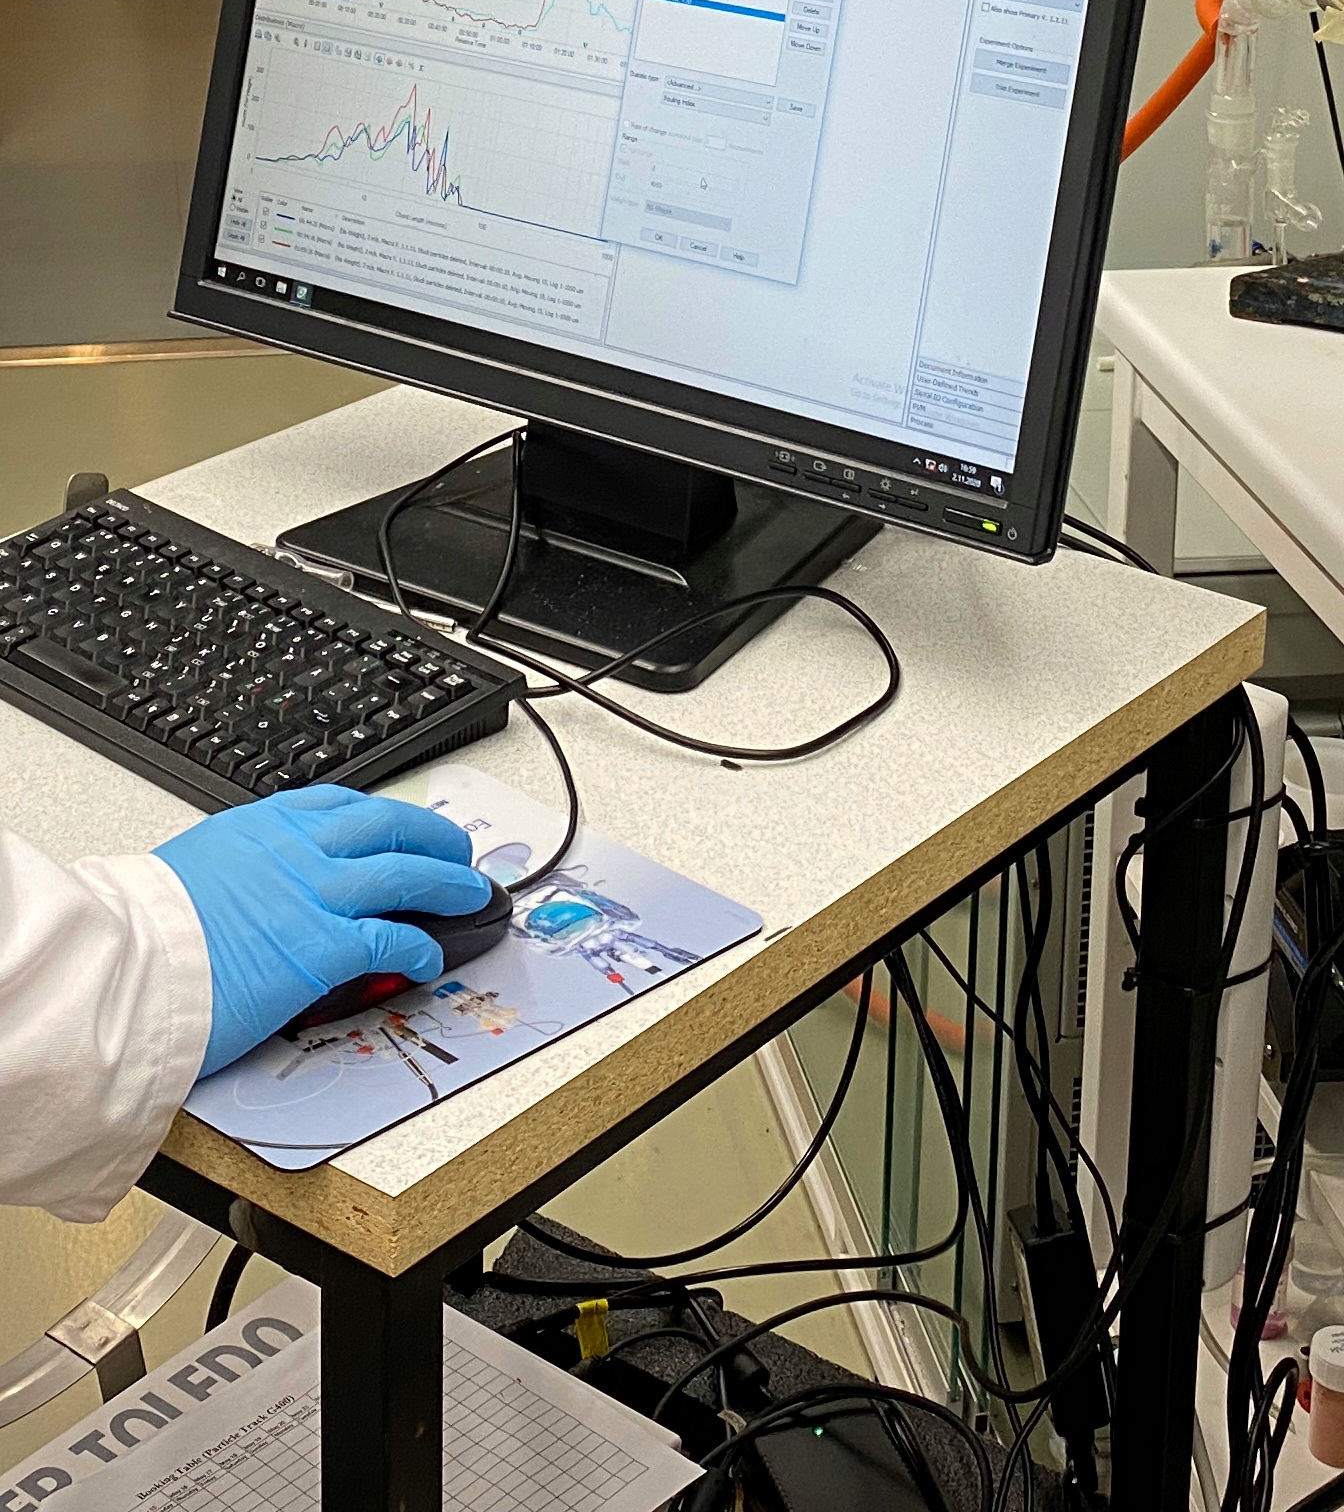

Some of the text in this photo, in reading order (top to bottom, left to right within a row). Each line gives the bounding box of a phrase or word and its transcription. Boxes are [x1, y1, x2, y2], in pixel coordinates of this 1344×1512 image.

[979, 37, 1034, 53] Experiment Options
[996, 59, 1014, 69] Merge
[918, 360, 988, 384] Document Information
[917, 375, 958, 392] User-Defined
[959, 385, 979, 397] Trends
[942, 395, 984, 413] Configuration
[910, 416, 934, 429] Process
[136, 1395, 296, 1501] Booking Table (Particle Track G400)
